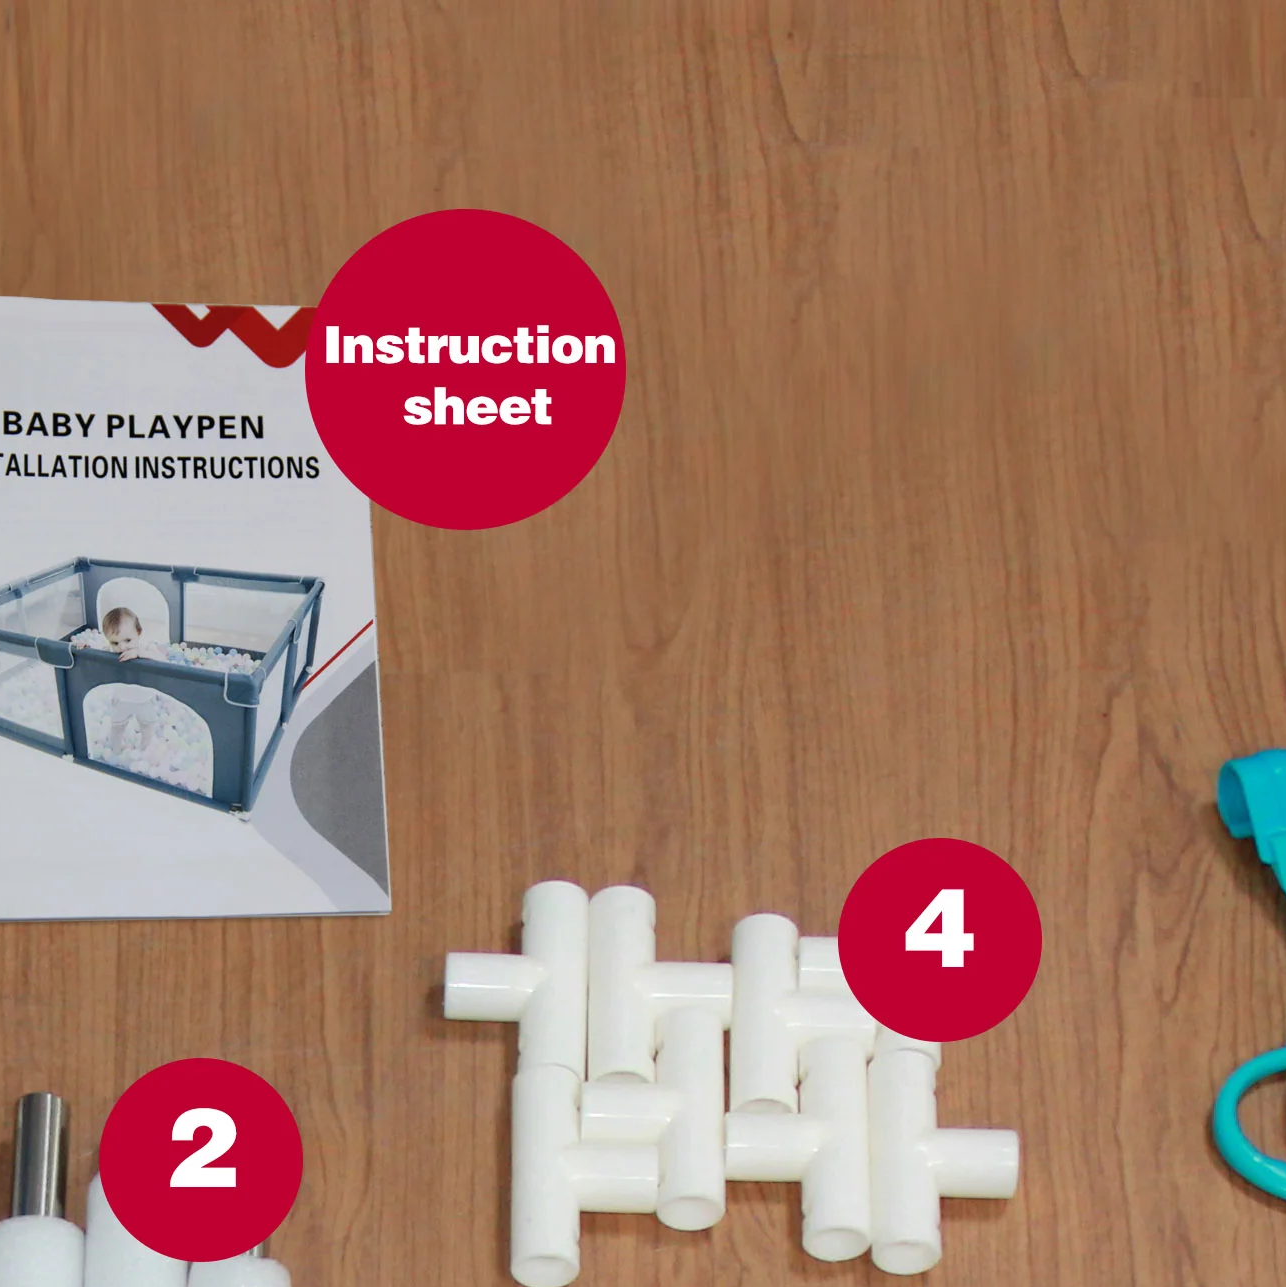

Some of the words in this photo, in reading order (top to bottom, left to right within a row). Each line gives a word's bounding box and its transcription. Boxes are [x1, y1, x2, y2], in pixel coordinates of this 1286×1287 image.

[3, 410, 96, 438] BABY
[106, 414, 265, 440] PLAYPEN
[134, 455, 321, 480] INSTRUCTIONS
